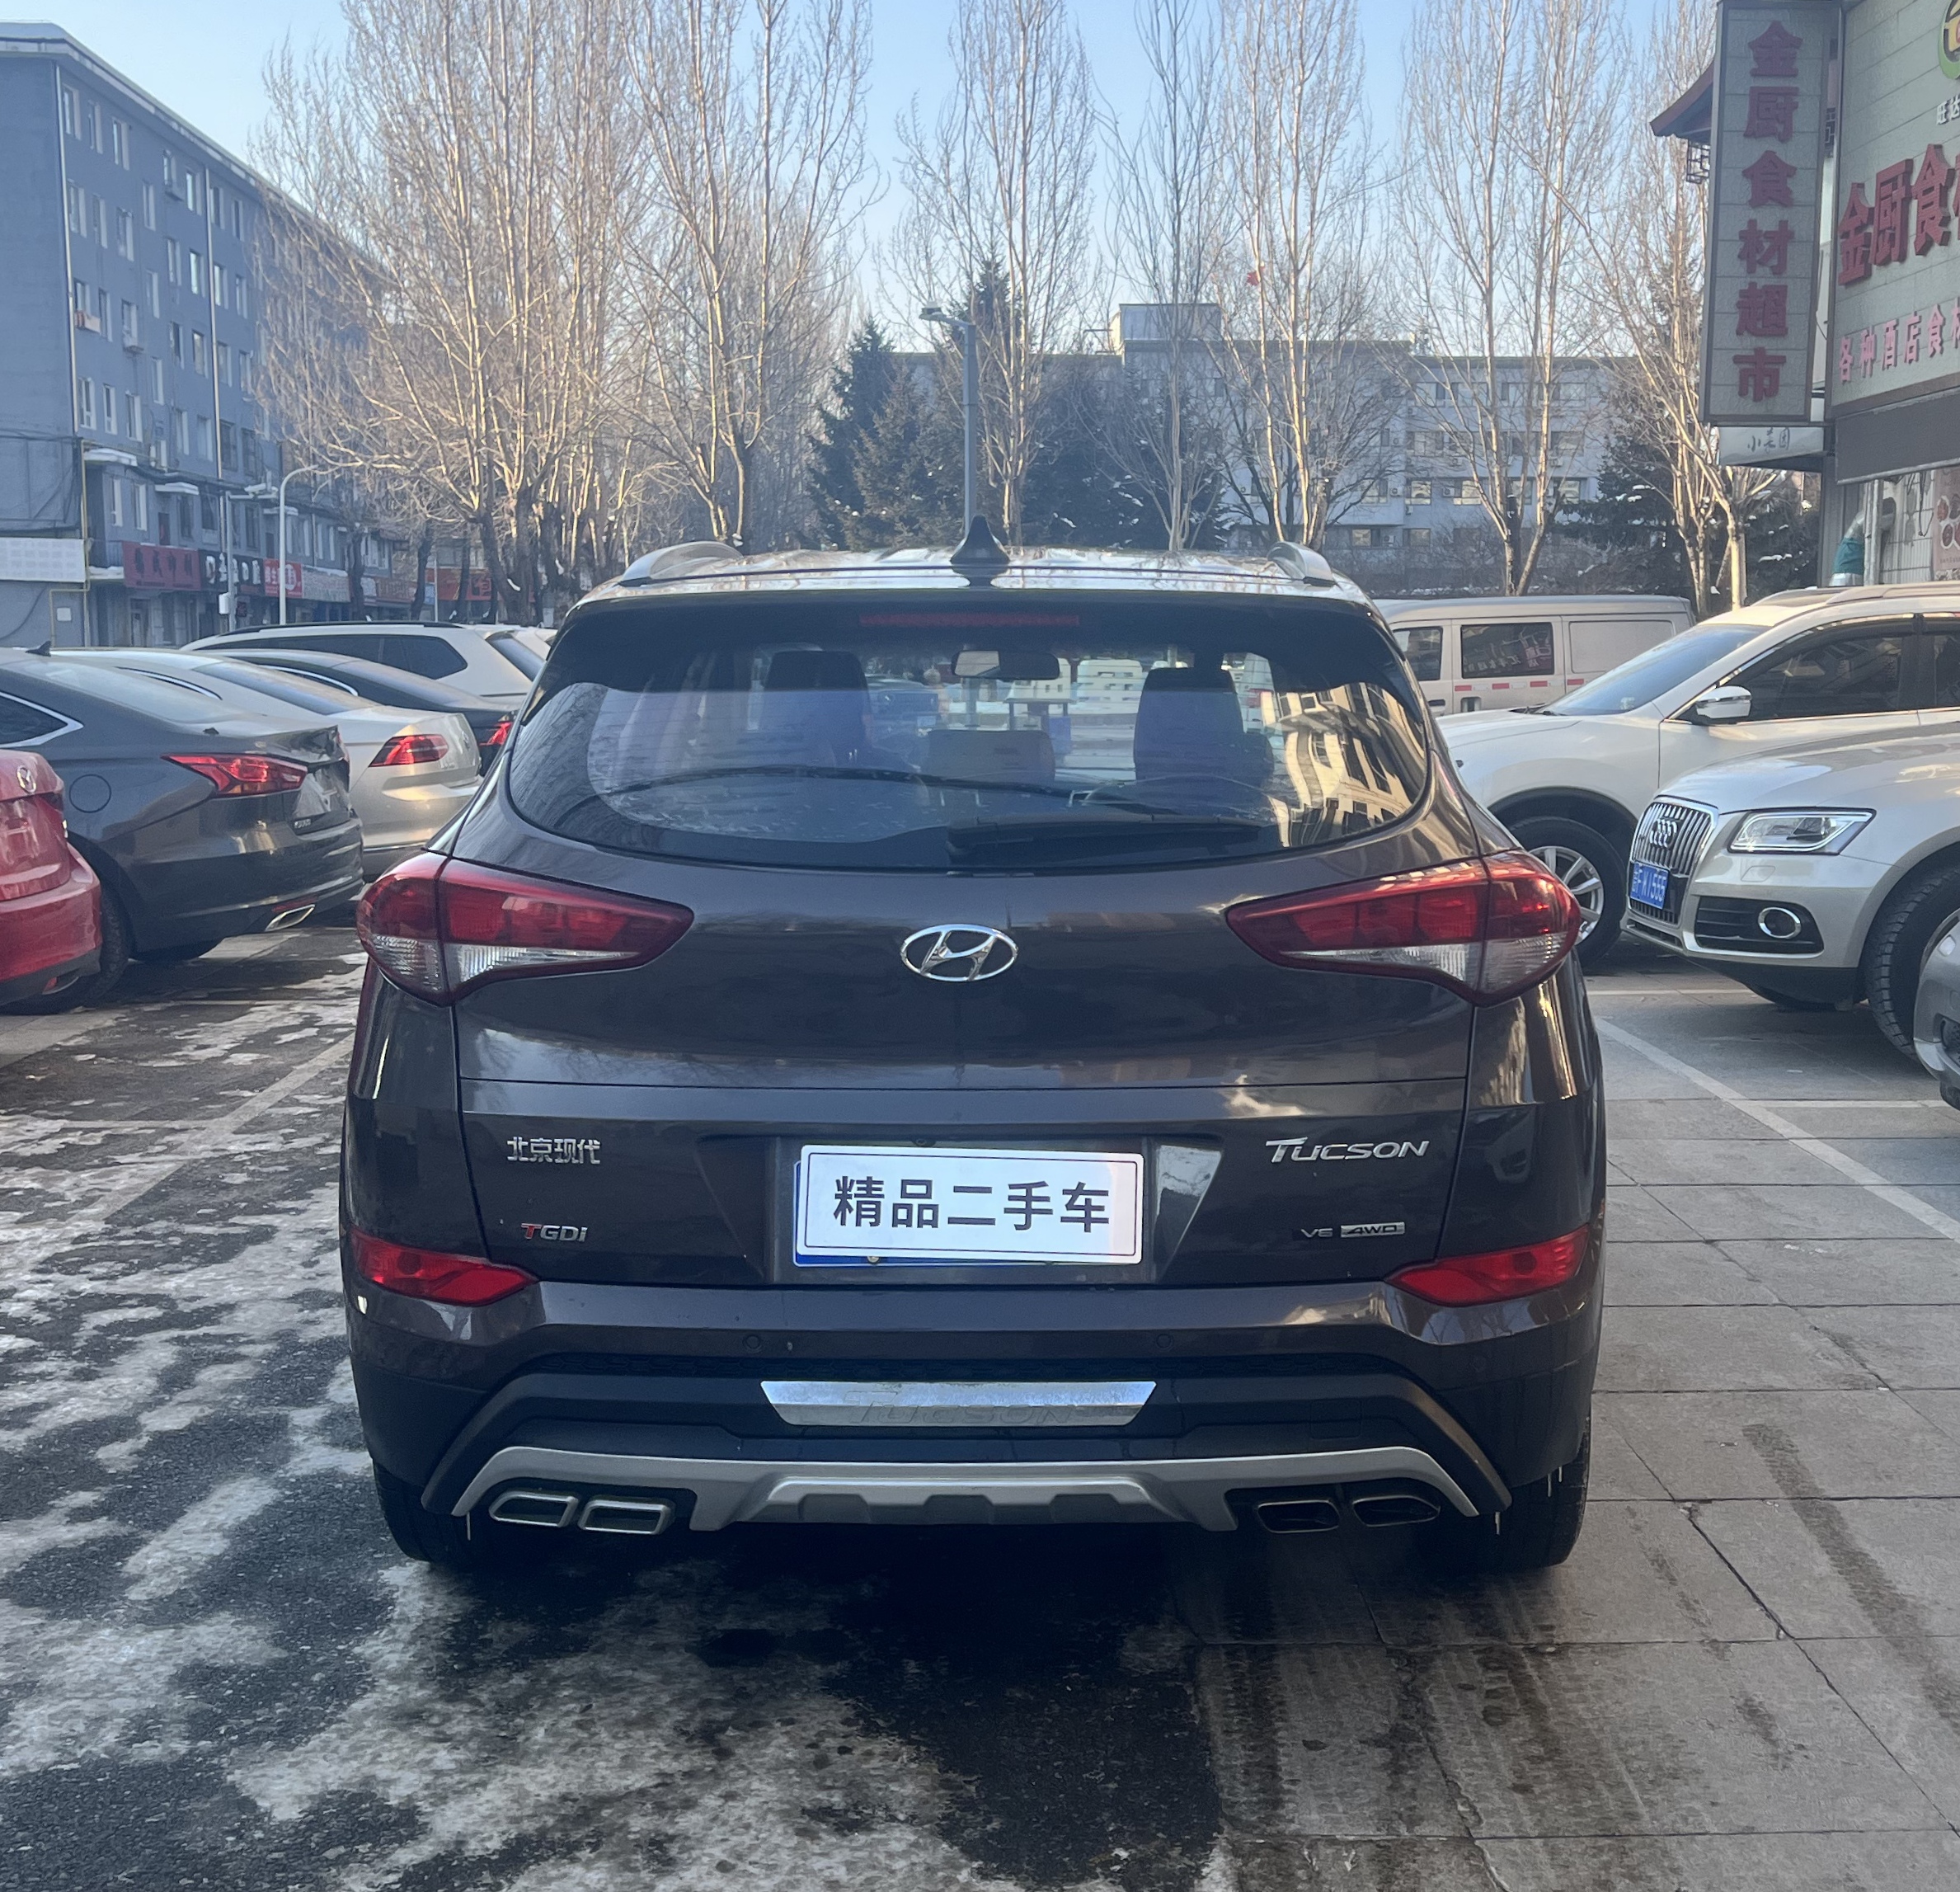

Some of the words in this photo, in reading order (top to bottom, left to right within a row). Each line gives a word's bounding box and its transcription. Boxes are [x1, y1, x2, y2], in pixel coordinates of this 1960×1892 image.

[1732, 20, 1803, 403] 金厨食材超市
[1838, 144, 1960, 285] 金厨食
[506, 1136, 601, 1165] 北京现代
[1265, 1137, 1430, 1164] TUCSON
[834, 1175, 1110, 1233] 精品二手车
[521, 1222, 588, 1242] TGDi
[1301, 1227, 1333, 1238] V6
[1345, 1224, 1400, 1236] 4WD
